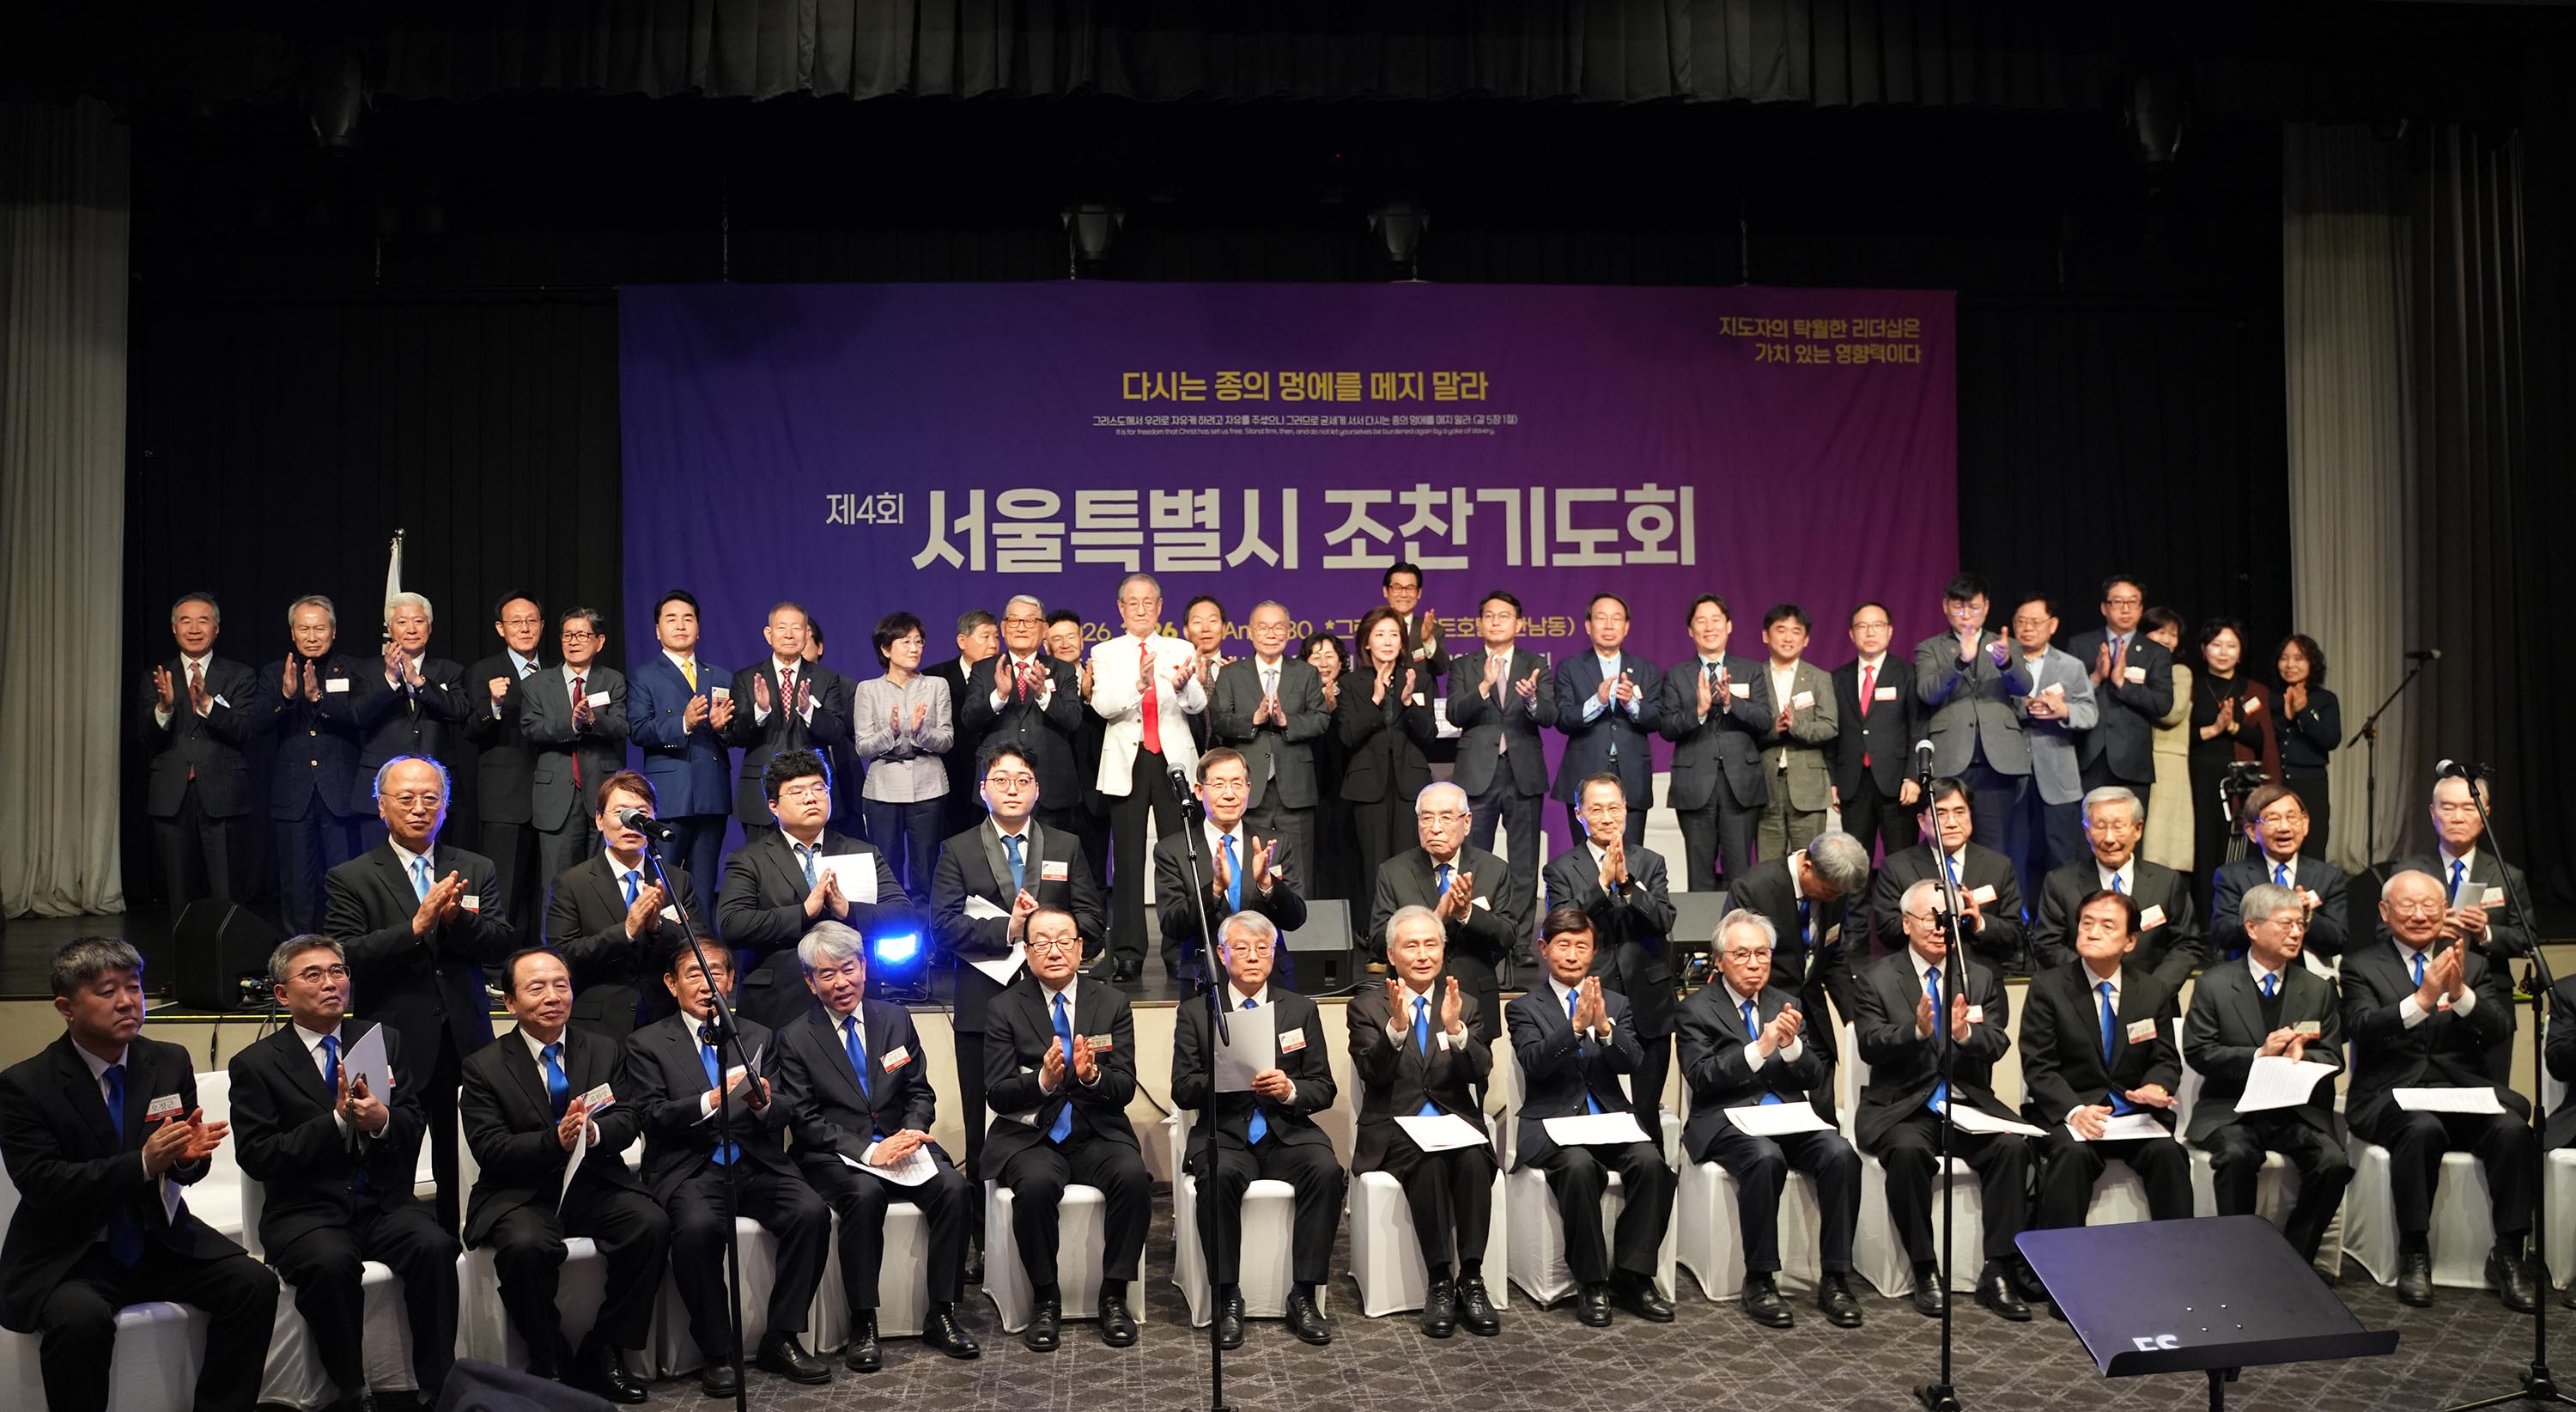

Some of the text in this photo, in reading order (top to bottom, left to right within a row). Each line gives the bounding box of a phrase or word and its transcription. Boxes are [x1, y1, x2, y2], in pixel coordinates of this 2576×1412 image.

[1719, 316, 1921, 339] 지도자의 탁월한 리더십은
[1754, 343, 1922, 364] 가치 있는 영향력이다
[1122, 371, 1488, 402] 다시는 종의 멍에를 메지 말라
[1145, 416, 1169, 426] 우리로
[1286, 416, 1319, 426] 그러므로
[1347, 416, 1364, 426] 서서
[1365, 416, 1390, 426] 다시는
[825, 483, 1696, 573] 제4회 서울특별시 조찬기도회
